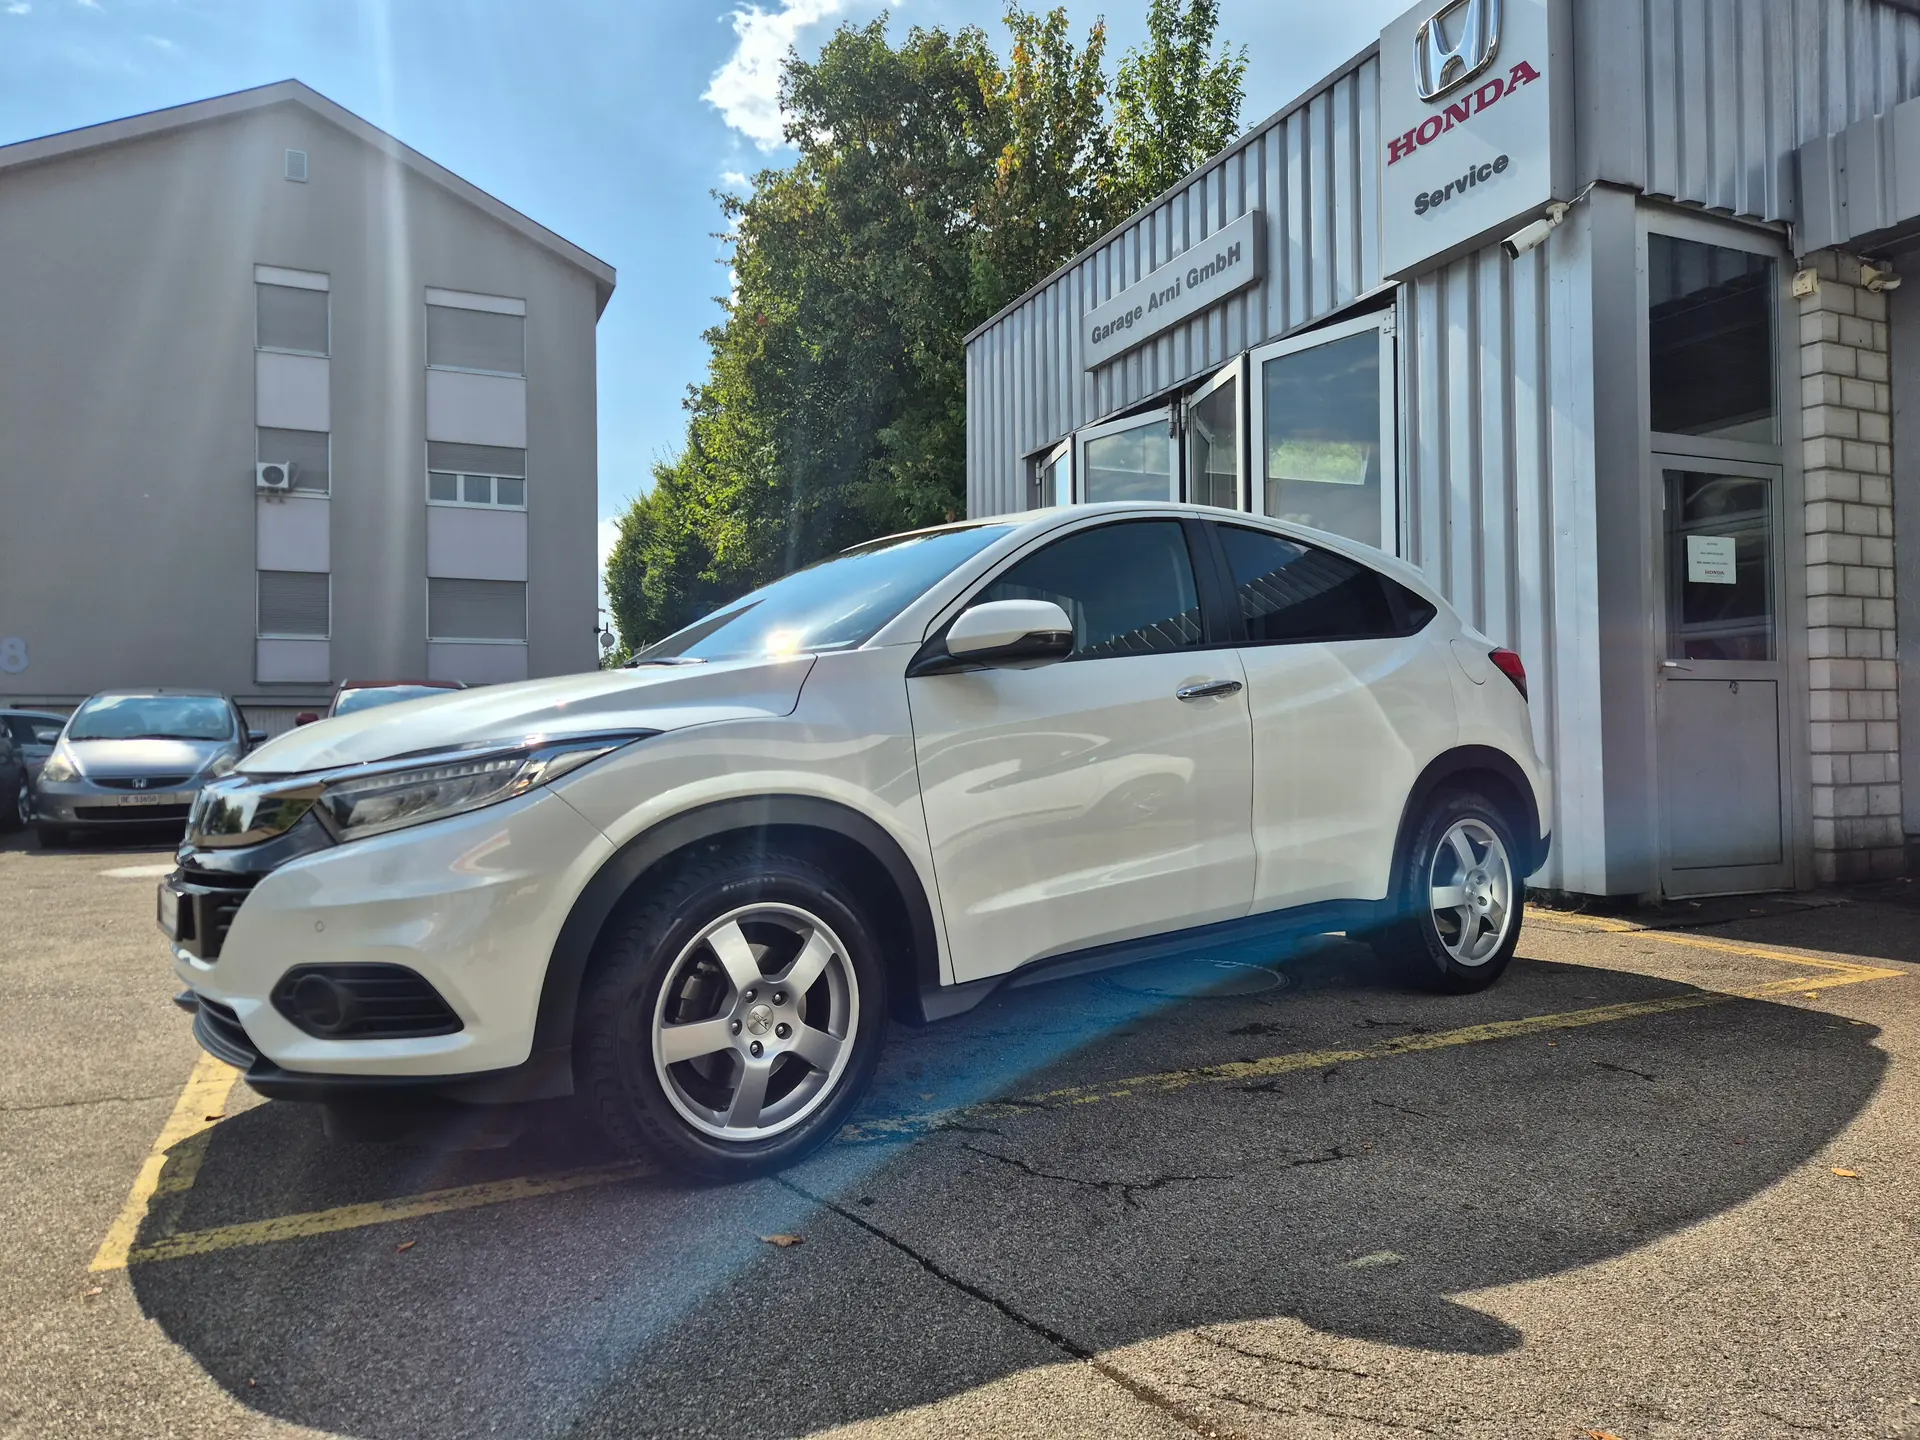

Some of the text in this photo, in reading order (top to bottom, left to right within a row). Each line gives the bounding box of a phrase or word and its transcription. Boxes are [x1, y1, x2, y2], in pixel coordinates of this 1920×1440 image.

[1387, 60, 1540, 167] HONDA
[1414, 154, 1509, 215] Service
[1091, 241, 1241, 344] Garage Arni GmbH
[0, 636, 29, 673] 8
